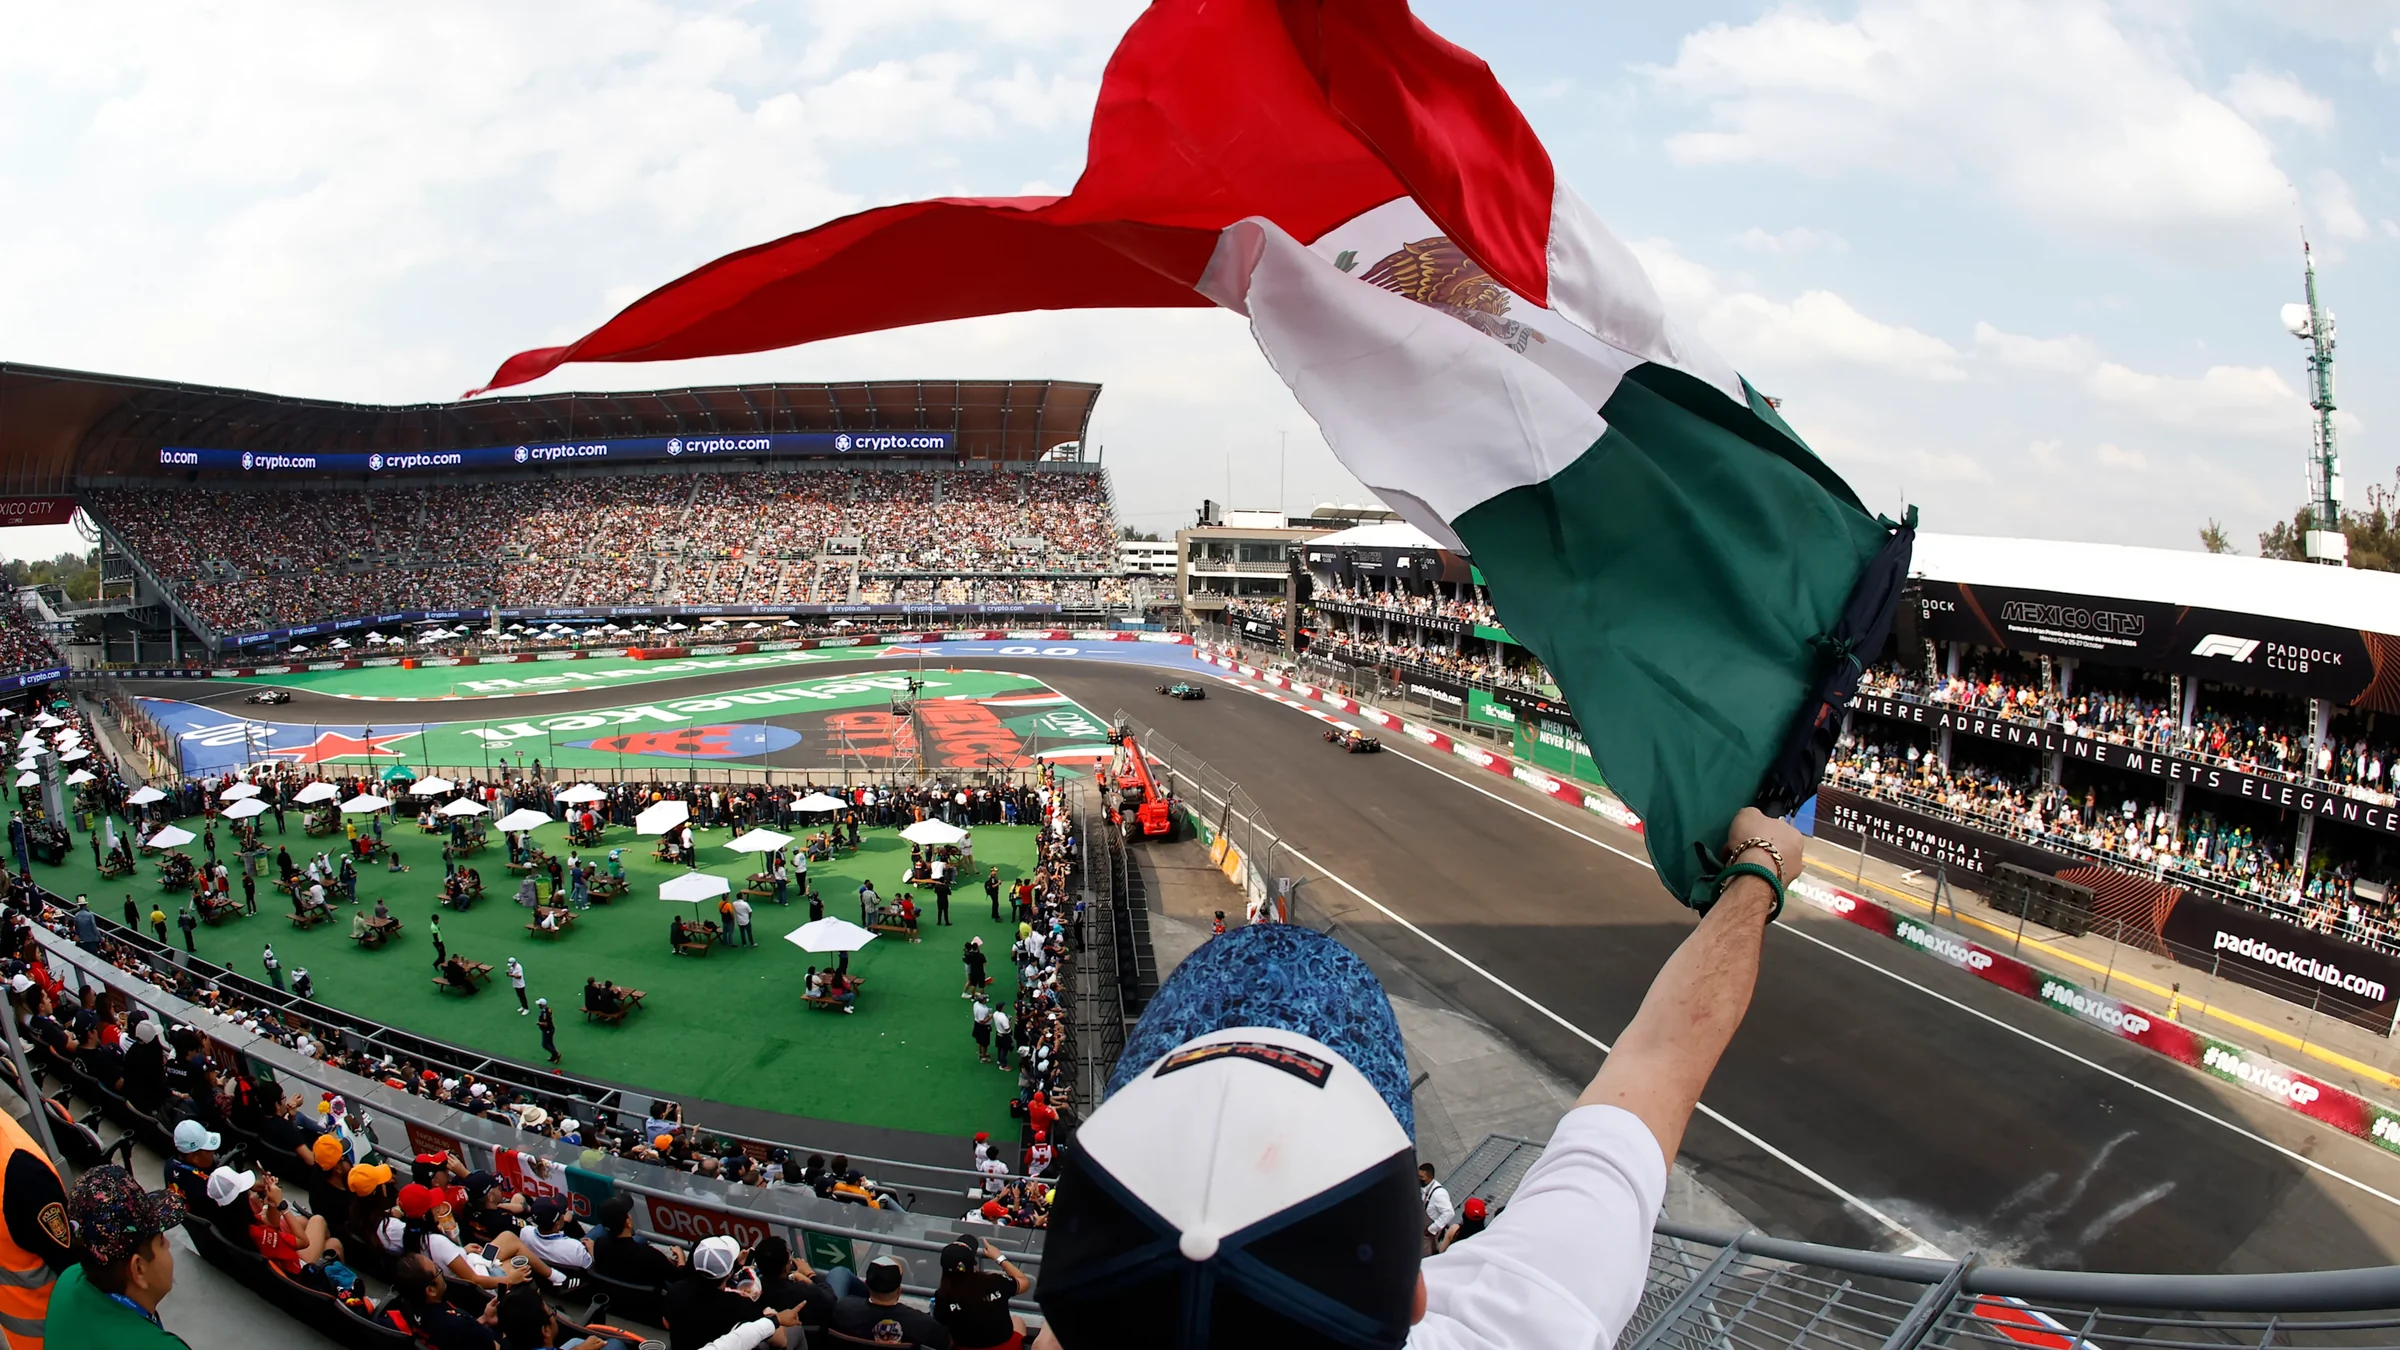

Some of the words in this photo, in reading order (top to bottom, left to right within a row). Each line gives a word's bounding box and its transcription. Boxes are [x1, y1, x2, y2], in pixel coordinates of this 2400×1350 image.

[531, 443, 608, 461] crypto.com
[686, 437, 771, 454] crypto.com
[855, 435, 944, 452] crypto.com
[255, 454, 316, 471] crypto.com
[386, 452, 461, 470] crypto.com
[0, 503, 27, 516] XICO
[28, 502, 55, 515] CITY
[552, 607, 584, 616] crypto.com
[618, 606, 651, 615] crypto.com
[687, 605, 723, 614] crypto.com
[759, 605, 796, 613] crypto.com
[834, 605, 871, 613] crypto.com
[987, 604, 1024, 613] crypto.com
[1921, 599, 1955, 611] DOCK
[430, 610, 459, 620] crypto.com
[1315, 601, 1335, 611] WHERE
[1338, 605, 1381, 619] ADRENALINE
[1385, 612, 1411, 624] MEETS
[1415, 617, 1460, 633] ELEGANCE
[2001, 601, 2091, 629] MEXICO
[2092, 611, 2144, 636] CITY
[243, 634, 269, 644] crypto.com
[690, 646, 737, 656] #MexicoGP
[2267, 642, 2342, 665] PADDOCK
[458, 652, 832, 690] Heineken
[2267, 655, 2309, 673] CLUB
[27, 670, 61, 684] crypto.com
[1045, 711, 1104, 737] CDMX
[1541, 718, 1563, 735] WHEN
[1565, 726, 1582, 741] YOU
[1539, 731, 1563, 748] NEVER
[1850, 696, 1923, 722] WHERE
[1940, 713, 2107, 762] ADRENALINE
[2126, 752, 2220, 788] MEETS
[2242, 779, 2399, 831] ELEGANCE
[1513, 766, 1560, 793] #MexicoGP
[1584, 795, 1641, 825] #MexicoGP
[1833, 816, 1867, 833] VIEW
[1872, 829, 1904, 846] LIKE
[1910, 841, 1930, 855] NO
[1834, 805, 1858, 820] SEE
[1865, 814, 1891, 831] THE
[1897, 824, 1965, 854] FORMULA
[1974, 848, 1980, 859] 1
[1897, 920, 1992, 970] #MexicoGP
[2214, 931, 2386, 1001] paddockclub.com
[2041, 980, 2150, 1035] #MexicoGP
[2203, 1046, 2319, 1105] #MexicoGP
[655, 1206, 714, 1236] ORO
[719, 1221, 763, 1249] 102
